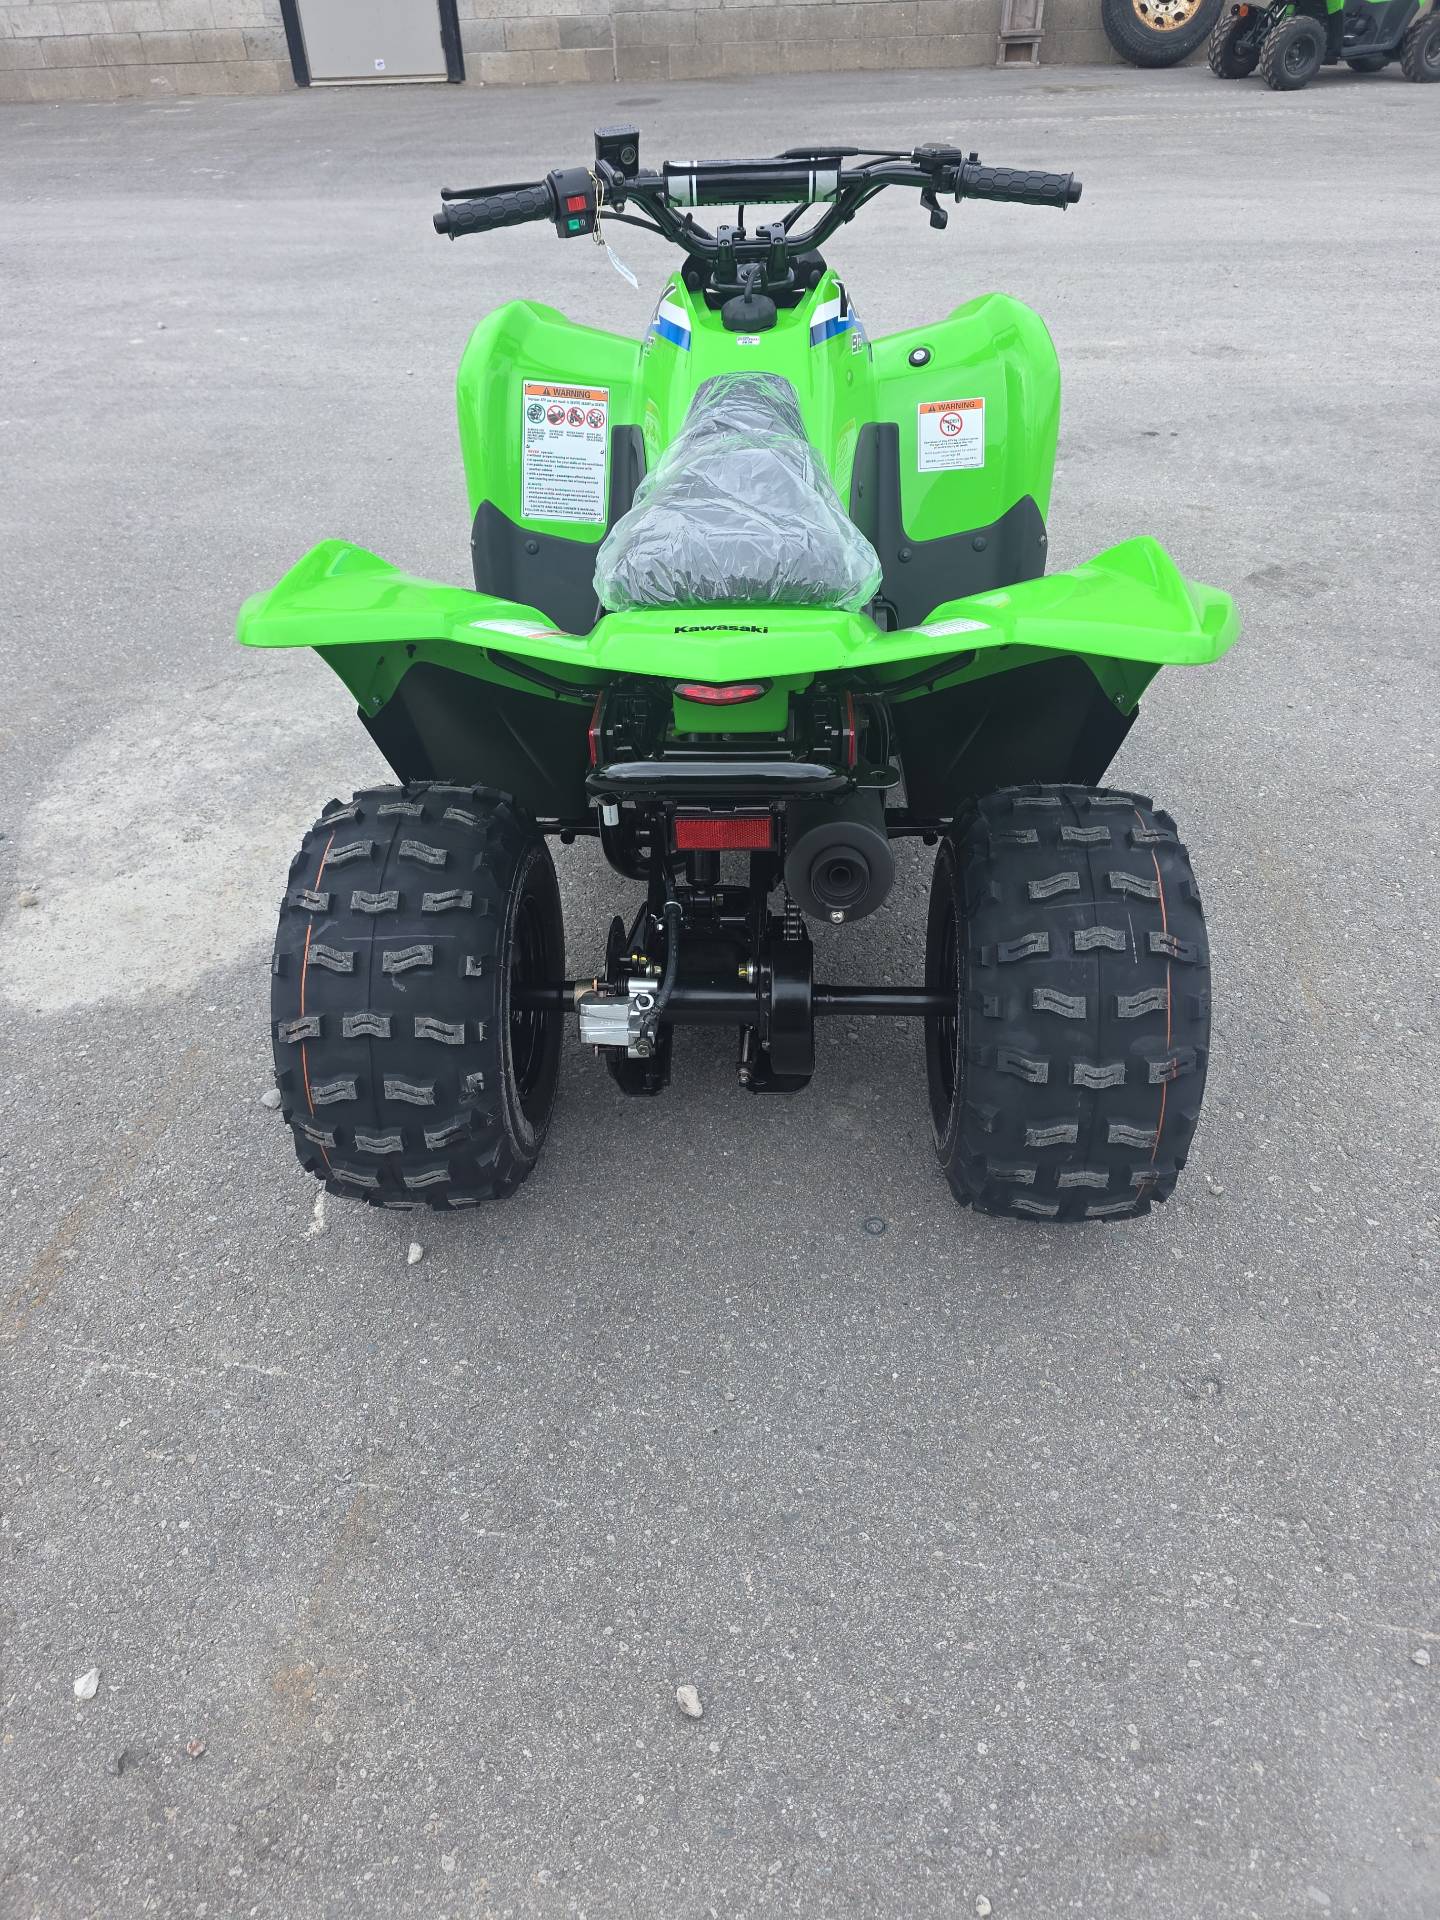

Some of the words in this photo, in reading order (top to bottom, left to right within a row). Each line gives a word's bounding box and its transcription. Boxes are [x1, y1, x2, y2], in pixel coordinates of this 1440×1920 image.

[553, 388, 591, 399] WARNING
[938, 401, 975, 411] WARNING
[674, 624, 769, 634] Kawasaki
